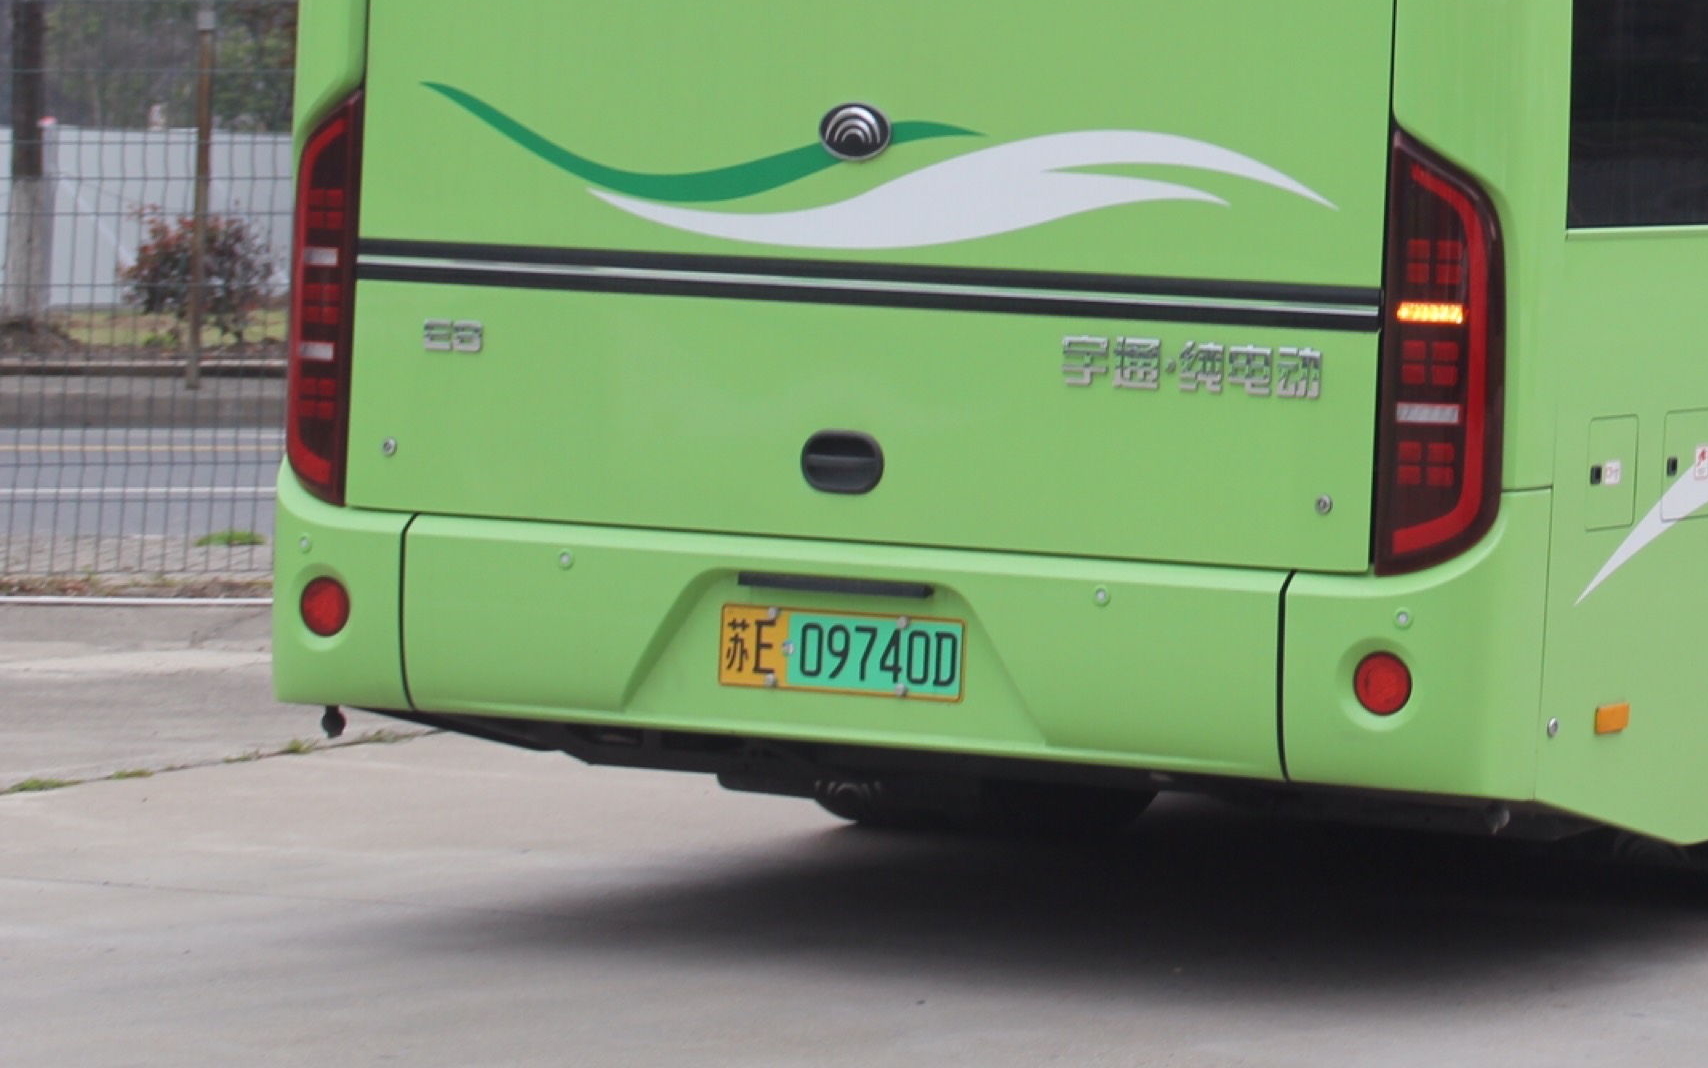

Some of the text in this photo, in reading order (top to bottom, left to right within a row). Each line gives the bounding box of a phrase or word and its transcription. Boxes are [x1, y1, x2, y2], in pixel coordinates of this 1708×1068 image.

[1062, 334, 1323, 399] 宇通·纯电动
[726, 618, 958, 687] 苏E 09740D
